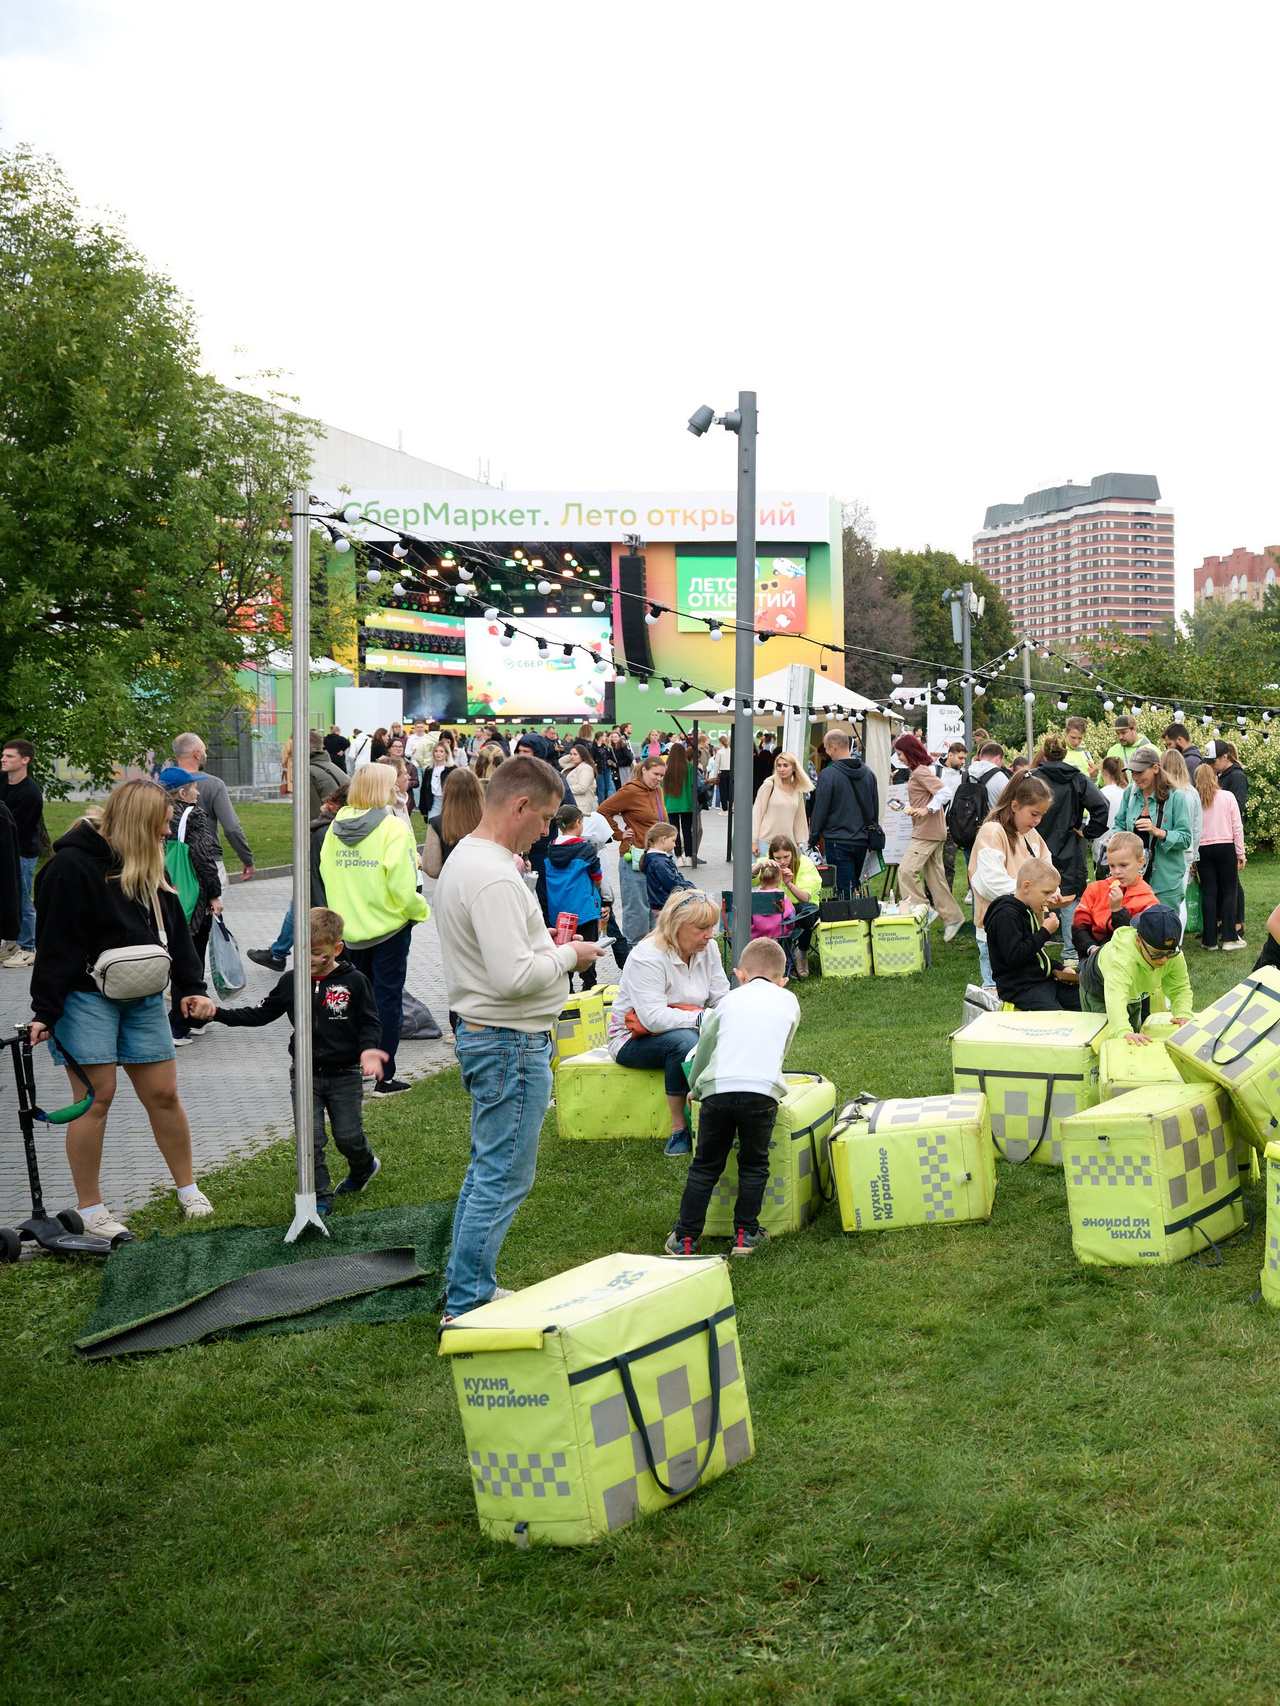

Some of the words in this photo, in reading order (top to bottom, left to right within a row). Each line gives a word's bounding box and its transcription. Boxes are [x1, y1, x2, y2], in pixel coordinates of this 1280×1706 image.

[560, 502, 636, 526] Лето
[647, 501, 795, 531] открыий
[688, 590, 796, 608] ОТКРТИЙ
[392, 656, 408, 666] Лето
[517, 660, 543, 668] СБЕР
[878, 1148, 894, 1203] районе
[870, 1180, 884, 1221] кухня
[884, 1206, 894, 1220] на
[1082, 1216, 1130, 1231] районе
[1133, 1218, 1150, 1228] на
[1110, 1227, 1151, 1239] кухня
[463, 1378, 509, 1398] кухня
[467, 1394, 485, 1407] на
[487, 1389, 550, 1411] районе
